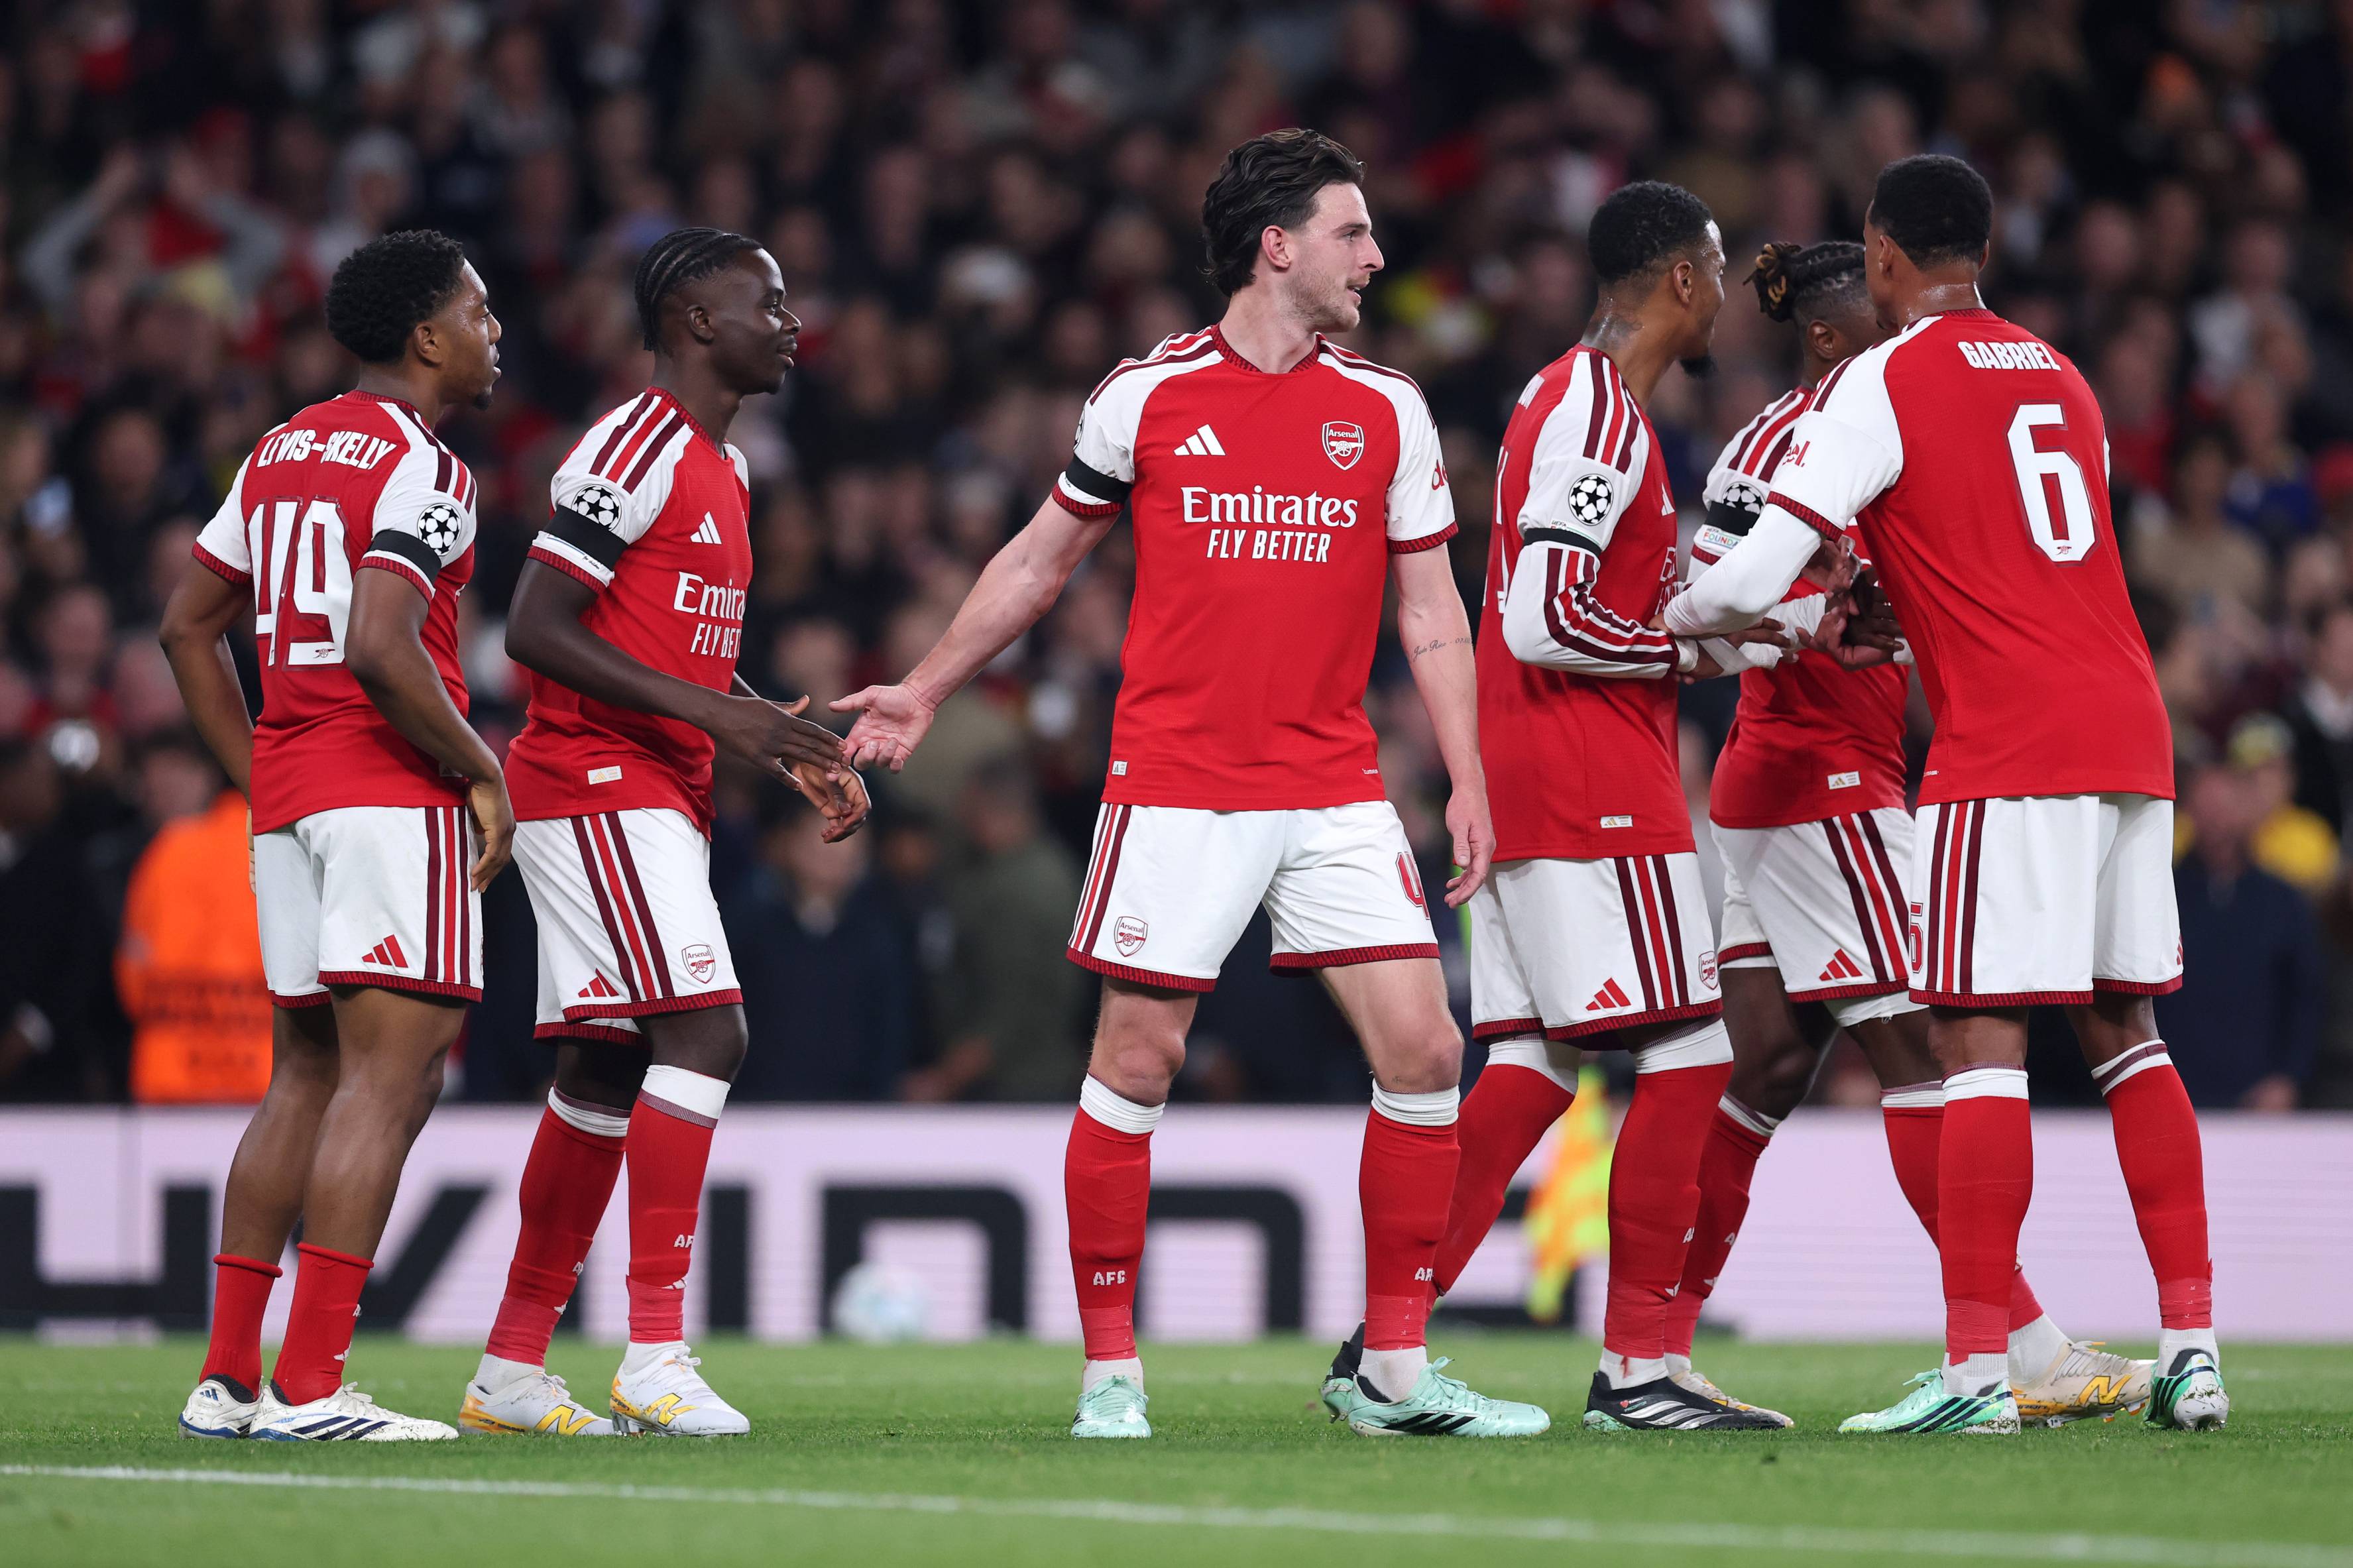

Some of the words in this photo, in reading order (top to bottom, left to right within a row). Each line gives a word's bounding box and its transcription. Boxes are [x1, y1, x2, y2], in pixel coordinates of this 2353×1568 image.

[1957, 341, 2062, 371] GABRIEL
[1328, 429, 1358, 438] Arsenal
[2006, 404, 2096, 562] 6
[1180, 484, 1358, 528] Emirates
[1206, 528, 1247, 559] FLY
[1251, 530, 1332, 563] BETTER
[247, 499, 354, 667] 49
[690, 622, 722, 656] FLY
[1395, 852, 1430, 920] 4
[1120, 922, 1143, 933] Arsenal
[687, 950, 710, 959] Arsenal
[1093, 1270, 1126, 1286] AFC
